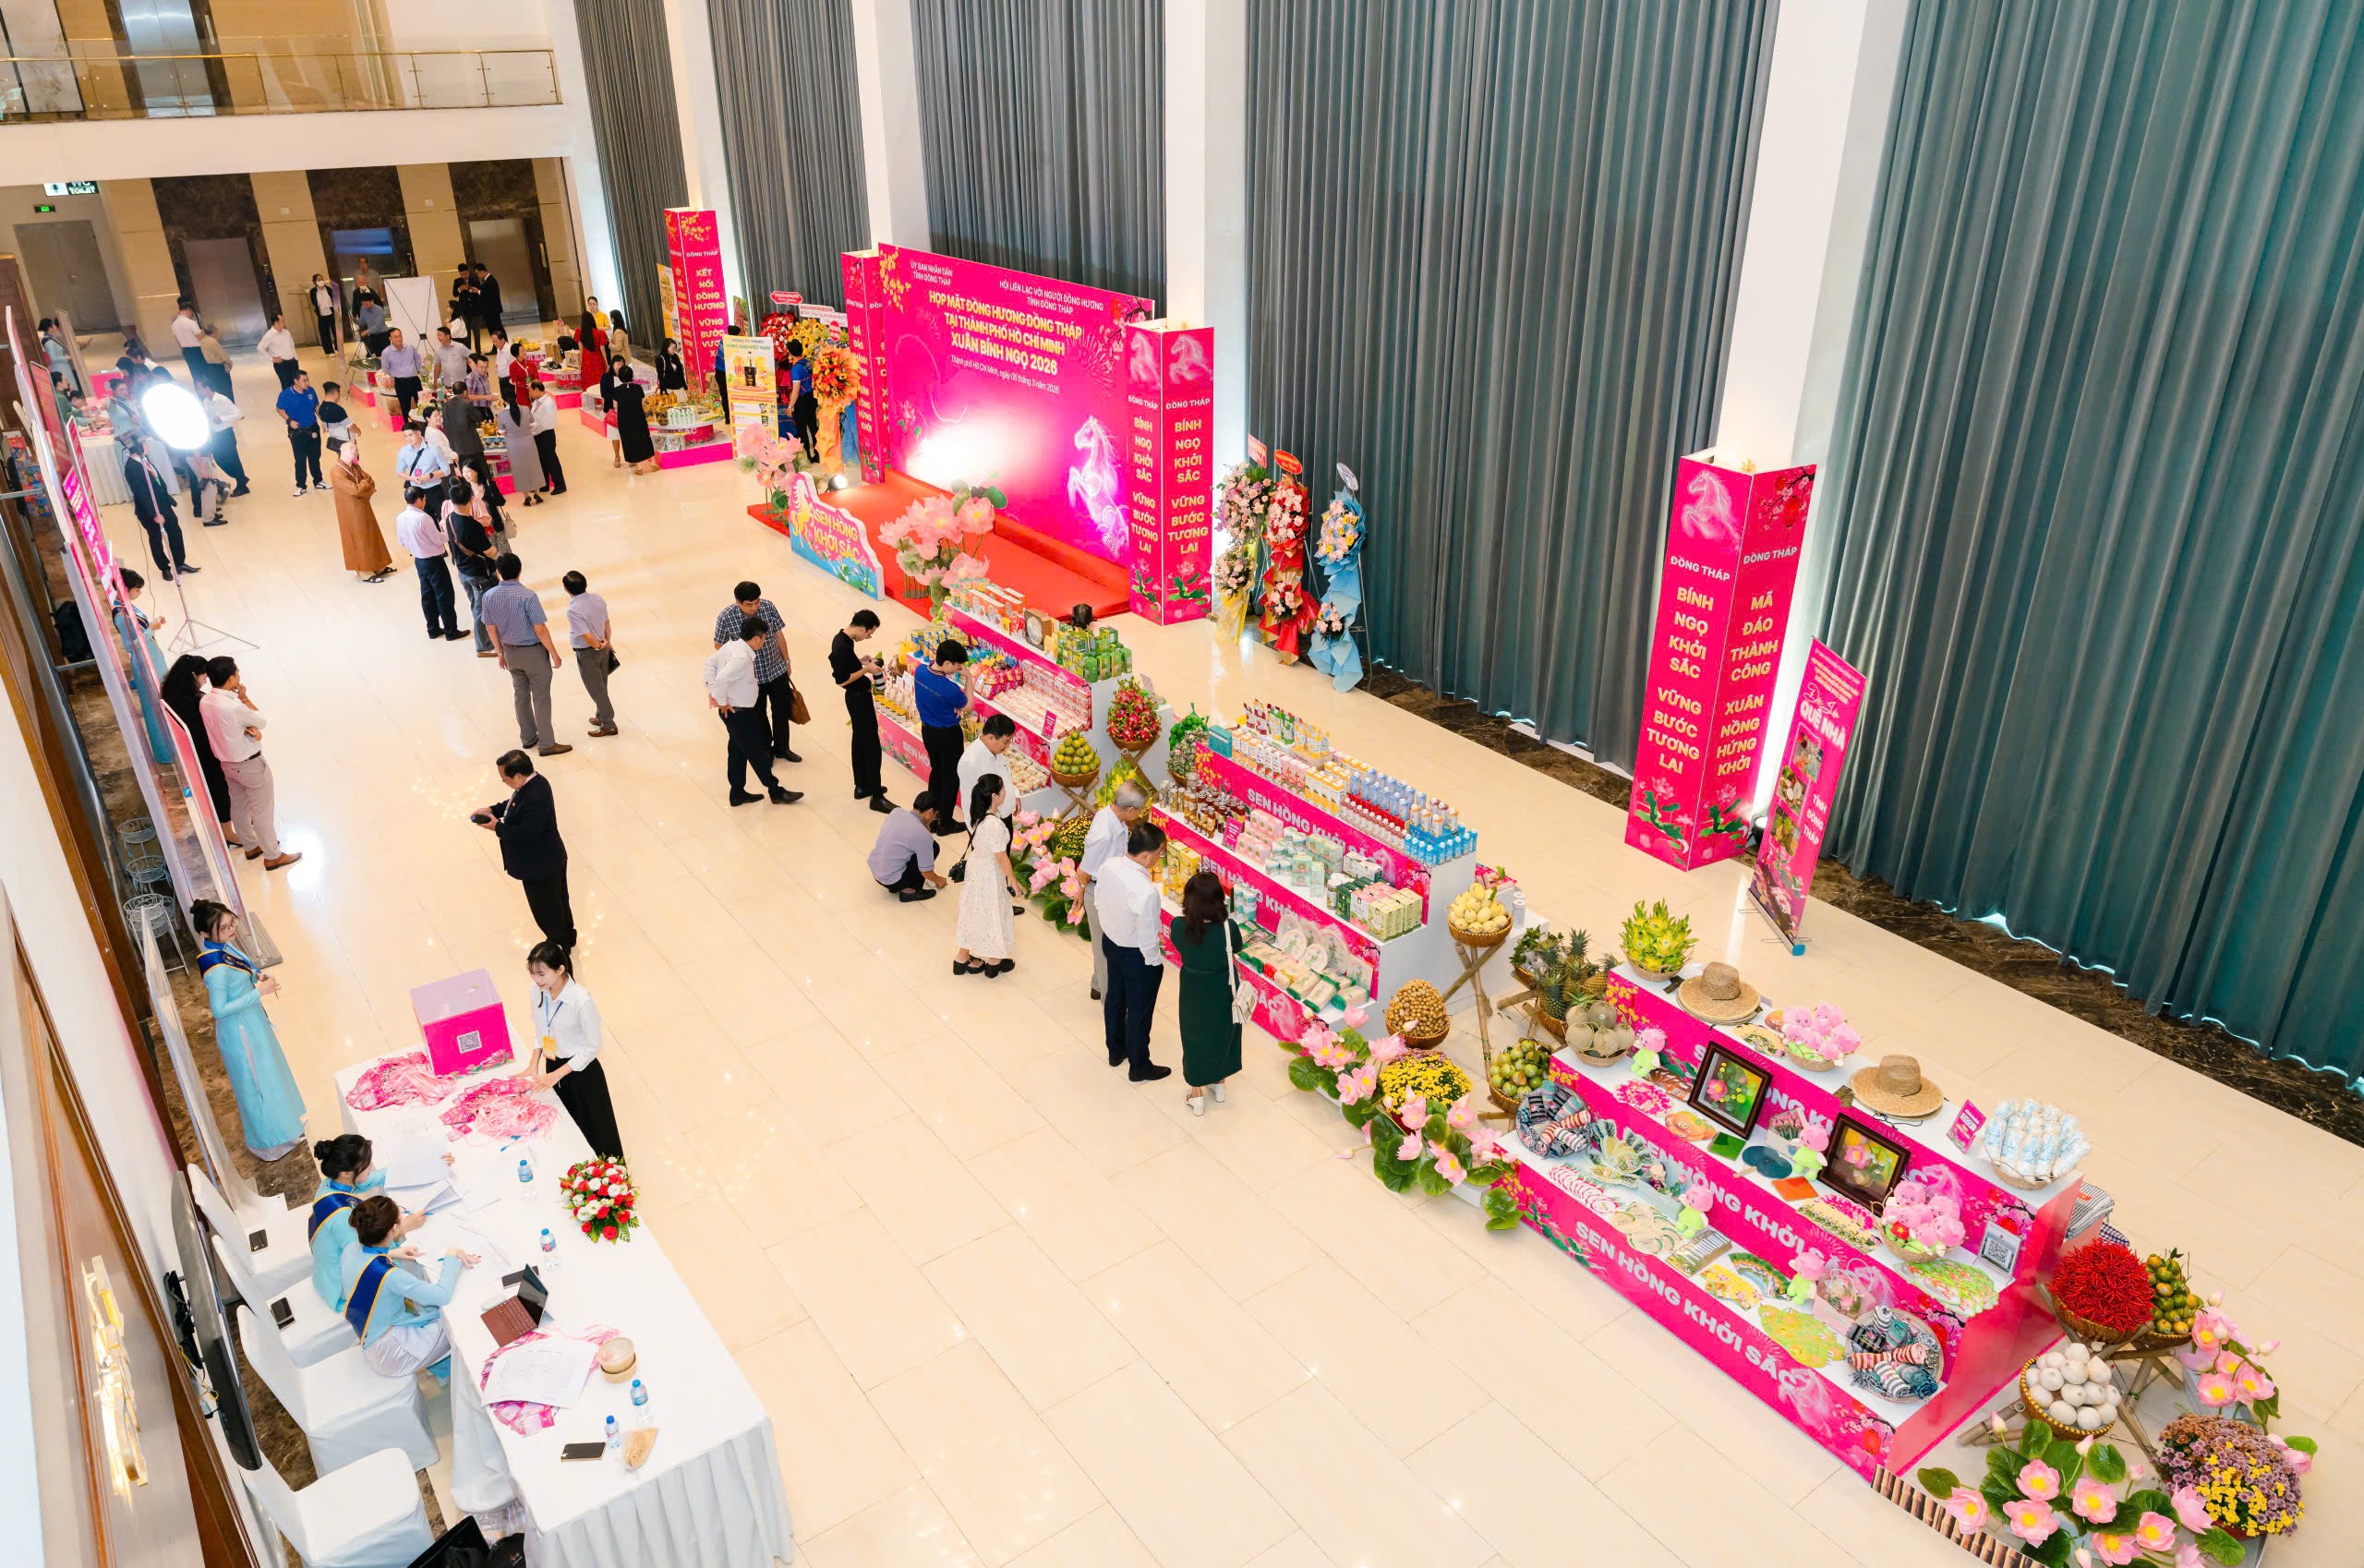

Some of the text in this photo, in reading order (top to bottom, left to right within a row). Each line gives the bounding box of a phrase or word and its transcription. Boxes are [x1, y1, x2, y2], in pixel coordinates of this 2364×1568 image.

[69, 186, 96, 194] TOILET
[695, 268, 713, 277] KẾT
[695, 292, 720, 301] ĐỒNG
[999, 279, 1104, 310] HỘI LIÊN LẠC VỚI NGƯỜI ĐỒNG HƯƠNG
[694, 301, 726, 311] HƯƠNG
[929, 290, 1082, 340] HỌP MẶT ĐỒNG HƯƠNG ĐỒNG THÁP
[1041, 299, 1056, 311] ĐỒNG
[1058, 303, 1073, 315] THÁP
[699, 318, 724, 327] VỮNG
[700, 329, 726, 338] BƯỚC
[945, 312, 1066, 356] TẠI THÀNH PHỐ HỒ CHÍ MINH
[951, 332, 1058, 375] XUÂN BÍNH NGỌ 2026
[1165, 397, 1211, 410] ĐỒNG THÁP
[1134, 416, 1152, 432] BÍNH
[1175, 418, 1202, 433] BÍNH
[1135, 436, 1152, 452] NGỌ
[1175, 438, 1200, 451] NGỌ
[1134, 452, 1152, 469] KHỞI
[1175, 452, 1202, 469] KHỞI
[1136, 467, 1152, 482] SẮC
[1176, 469, 1200, 483] SẮC
[1132, 491, 1156, 509] VỮNG
[1171, 495, 1205, 510] VỮNG
[814, 508, 857, 542] SEN HỒNG
[1133, 510, 1156, 526] BƯỚC
[1171, 512, 1205, 526] BƯỚC
[1130, 523, 1158, 542] TƯƠNG
[1167, 526, 1208, 542] TƯƠNG
[814, 526, 861, 565] KHỞI SẮC
[1140, 540, 1152, 554] LAI
[1180, 542, 1199, 554] LAI
[1743, 546, 1798, 565] ĐỒNG THÁP
[1670, 554, 1731, 582] ĐỒNG THÁP
[1677, 586, 1714, 611] BÍNH
[1751, 590, 1773, 611] MÃ
[1673, 611, 1708, 637] NGỌ
[1742, 617, 1773, 635] ĐÁO
[1670, 635, 1707, 659] KHỞI
[1731, 639, 1779, 662] THÀNH
[1670, 657, 1701, 679] SẮC
[1731, 661, 1771, 681] CÔNG
[1658, 687, 1702, 715] VỮNG
[1724, 694, 1764, 716] XUÂN
[1653, 709, 1698, 737] BƯỚC
[1719, 717, 1760, 739] NỒNG
[1801, 700, 1845, 752] QUÊ NHÀ
[1646, 727, 1700, 760] TƯƠNG
[1716, 737, 1757, 759] HỨNG
[1658, 754, 1684, 774] LAI
[1718, 756, 1752, 777] KHỞI
[1248, 789, 1272, 811] SEN
[1272, 802, 1309, 833] HỒNG
[1813, 794, 1827, 814] TỈNH
[1806, 809, 1824, 831] ĐỒNG
[1804, 824, 1819, 844] THÁP
[1202, 855, 1225, 877] SEN
[1743, 1203, 1804, 1254] KHỞI
[1575, 1220, 1797, 1392] SEN HỒNG KHỞI SẮC
